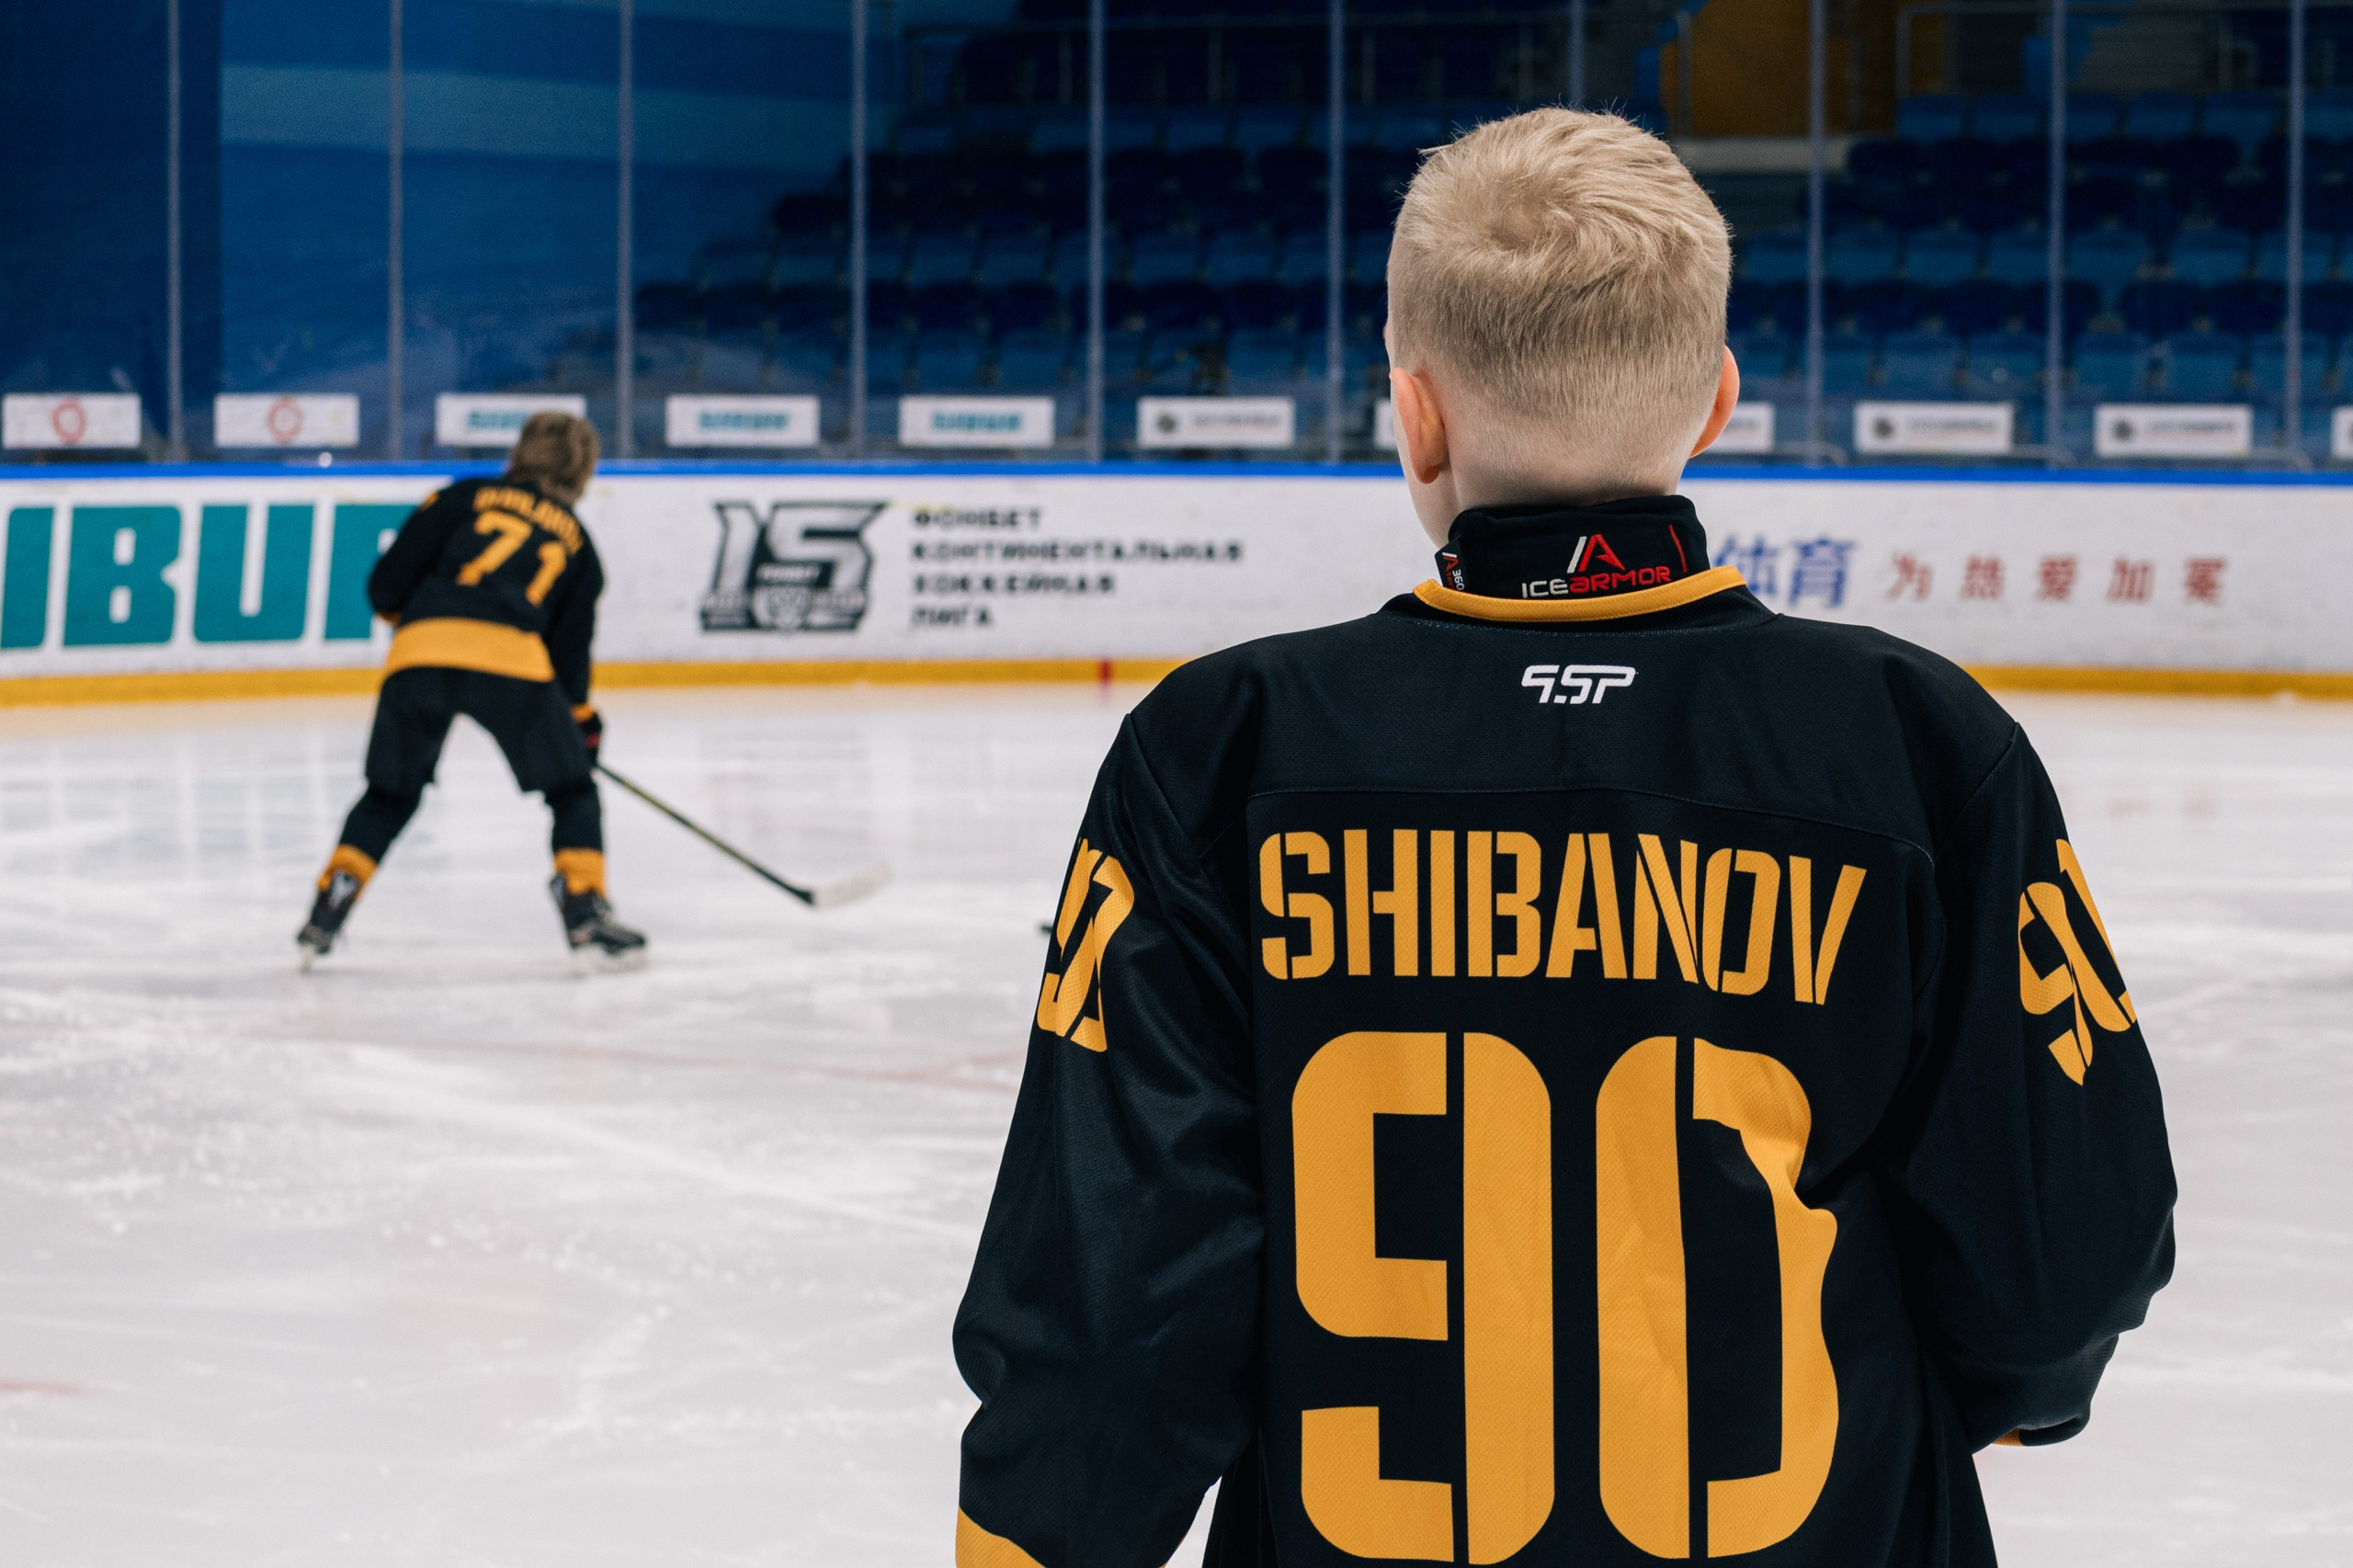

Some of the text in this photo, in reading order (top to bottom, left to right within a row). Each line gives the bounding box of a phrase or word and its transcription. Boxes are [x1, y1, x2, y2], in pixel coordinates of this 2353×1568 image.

[456, 509, 567, 608] 71
[702, 501, 885, 612] 15
[1452, 569, 1465, 591] 360
[1258, 828, 1868, 1006] SHIBANOV
[1291, 1030, 1839, 1565] 90
